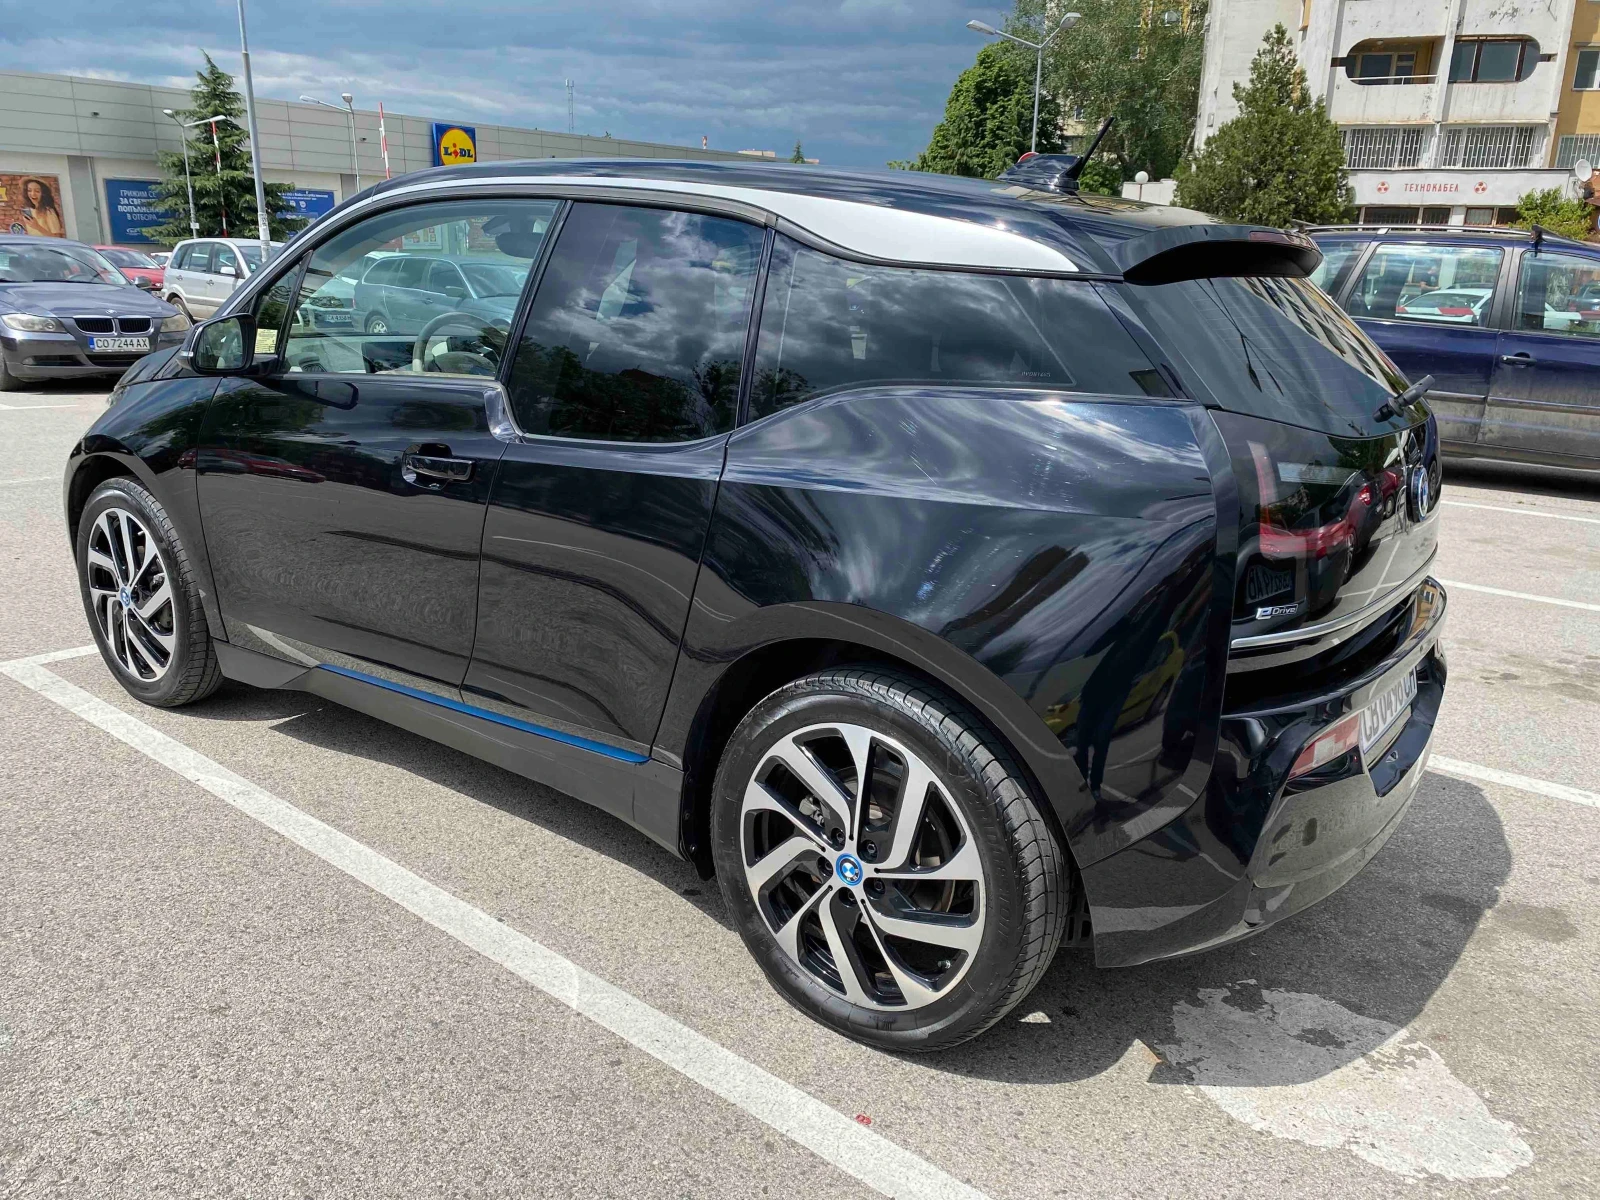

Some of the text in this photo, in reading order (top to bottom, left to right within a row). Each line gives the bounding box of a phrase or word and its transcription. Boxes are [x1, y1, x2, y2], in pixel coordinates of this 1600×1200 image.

[443, 142, 474, 159] LIDL
[1404, 183, 1459, 192] ТЕХНОКАБЕЛ
[110, 339, 134, 348] 7244
